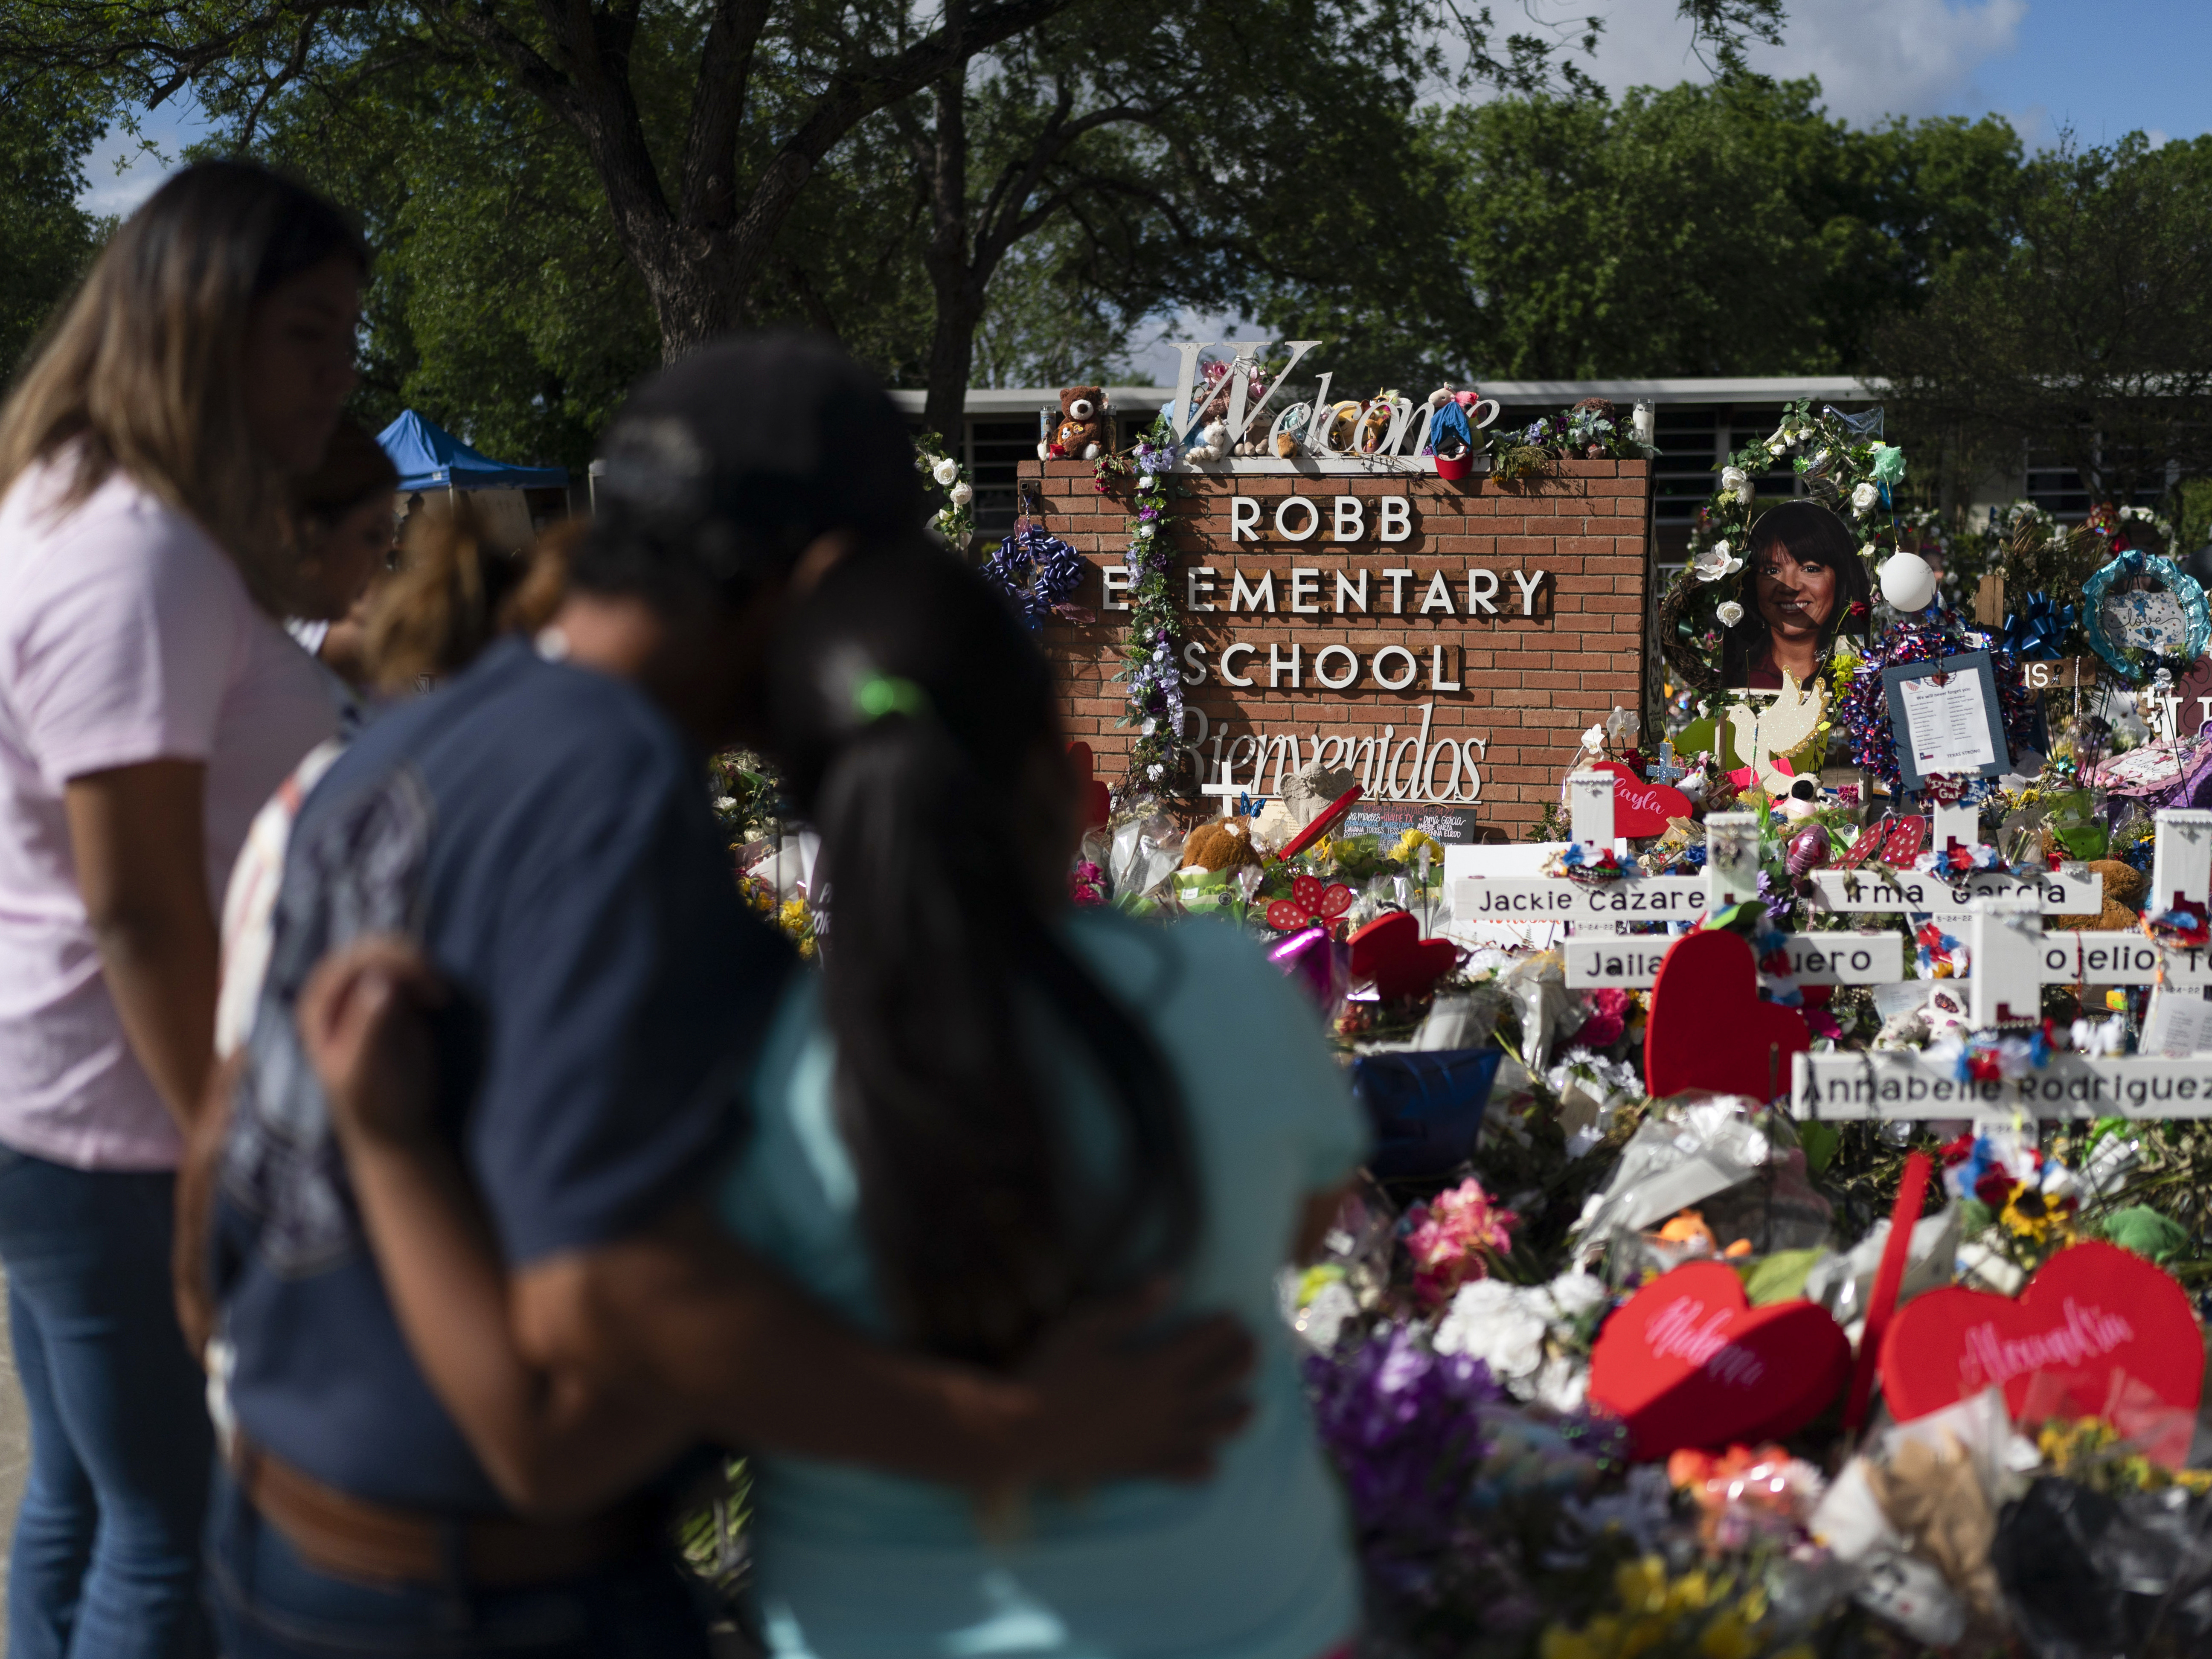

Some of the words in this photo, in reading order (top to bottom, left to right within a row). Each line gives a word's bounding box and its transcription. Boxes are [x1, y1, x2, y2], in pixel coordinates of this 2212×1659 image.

[1169, 341, 1500, 462] Welcome
[1232, 496, 1411, 542] ROBB
[1103, 567, 1544, 615] EEMENTARY
[2108, 608, 2181, 629] love
[1183, 642, 1460, 691] SCHOOL
[2025, 663, 2049, 689] IS
[1168, 703, 1487, 802] Bienvenidos
[1930, 780, 1960, 790] Irma
[1346, 812, 1357, 821] va
[1363, 805, 1382, 814] ROBB
[1383, 805, 1428, 816] ELEMENTARY
[1384, 814, 1403, 822] UVALDE
[1404, 814, 1414, 823] TX
[1441, 815, 1466, 826] Garcia
[1479, 890, 1572, 912] Jackie
[1589, 890, 1705, 912] Cazare
[1952, 881, 2066, 904] Garcia
[1586, 951, 1663, 976] Jaila
[2046, 946, 2155, 979] ojelio
[1801, 1072, 2001, 1103] Annabelle
[2018, 1074, 2212, 1106] Rodriguez
